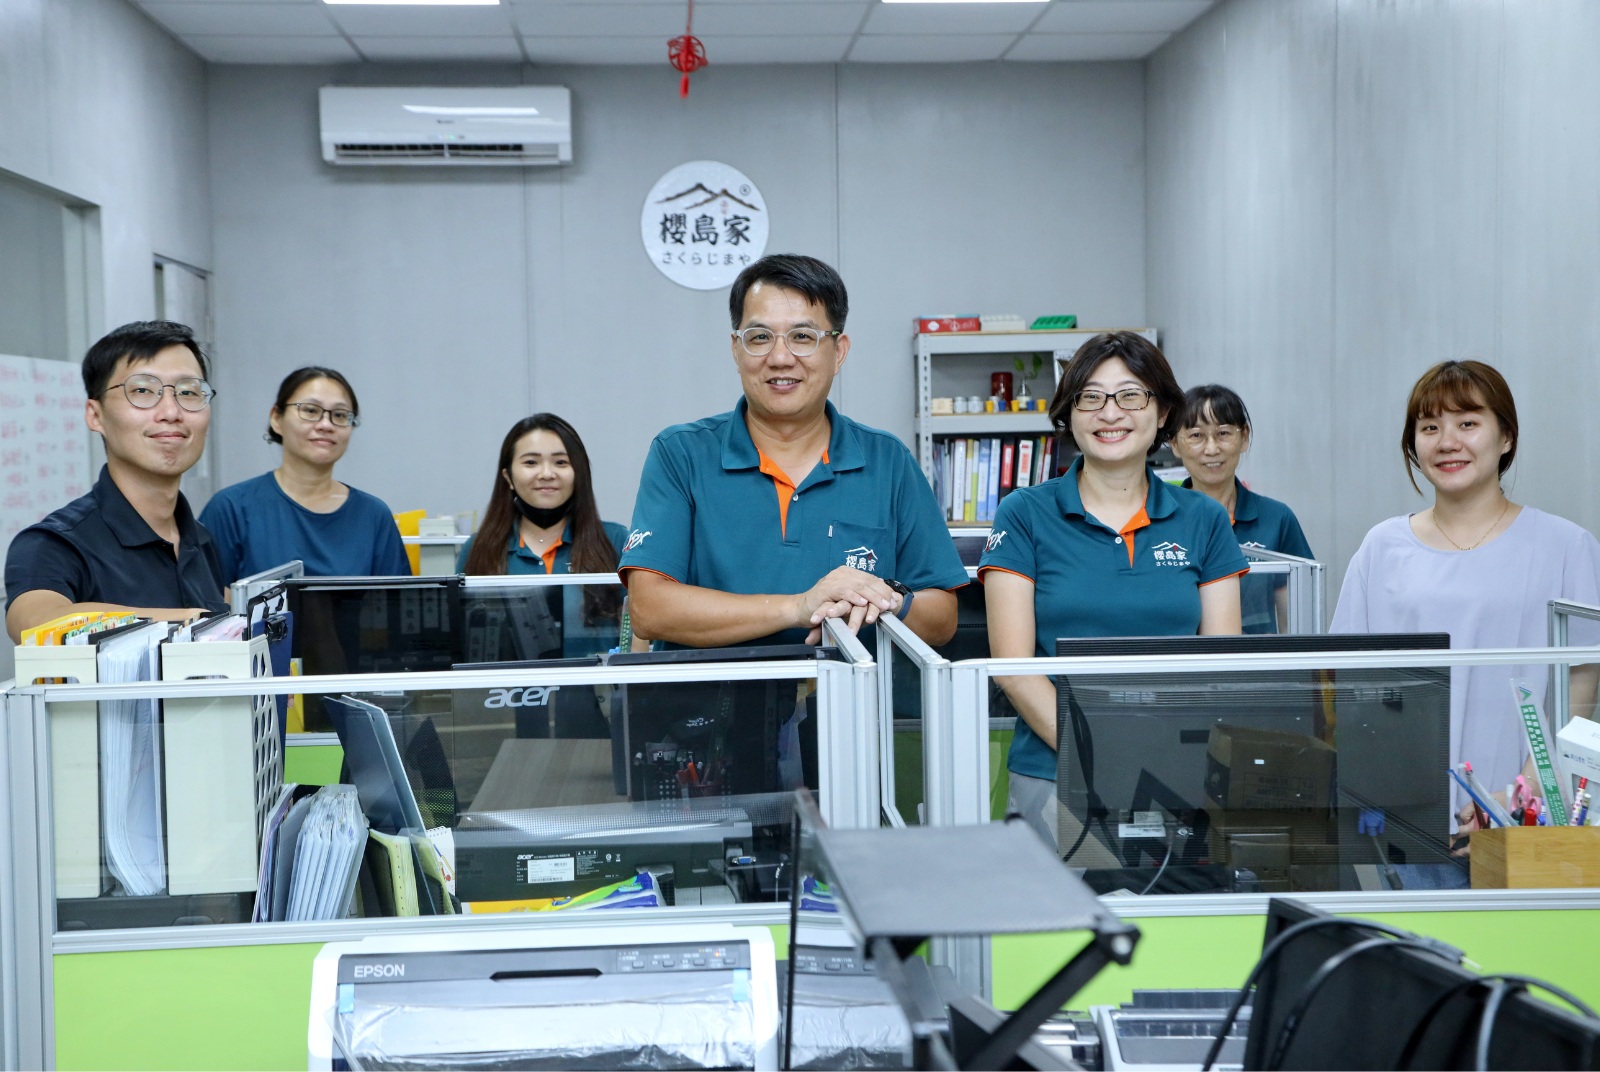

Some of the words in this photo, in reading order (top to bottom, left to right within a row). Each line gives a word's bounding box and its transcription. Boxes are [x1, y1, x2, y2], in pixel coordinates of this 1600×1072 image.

[660, 213, 752, 246] 櫻島家
[662, 251, 751, 266] さくらじまや
[846, 555, 876, 571] 櫻島家
[1154, 551, 1187, 560] 櫻島家
[484, 686, 561, 709] acer
[354, 964, 405, 978] EPSON
